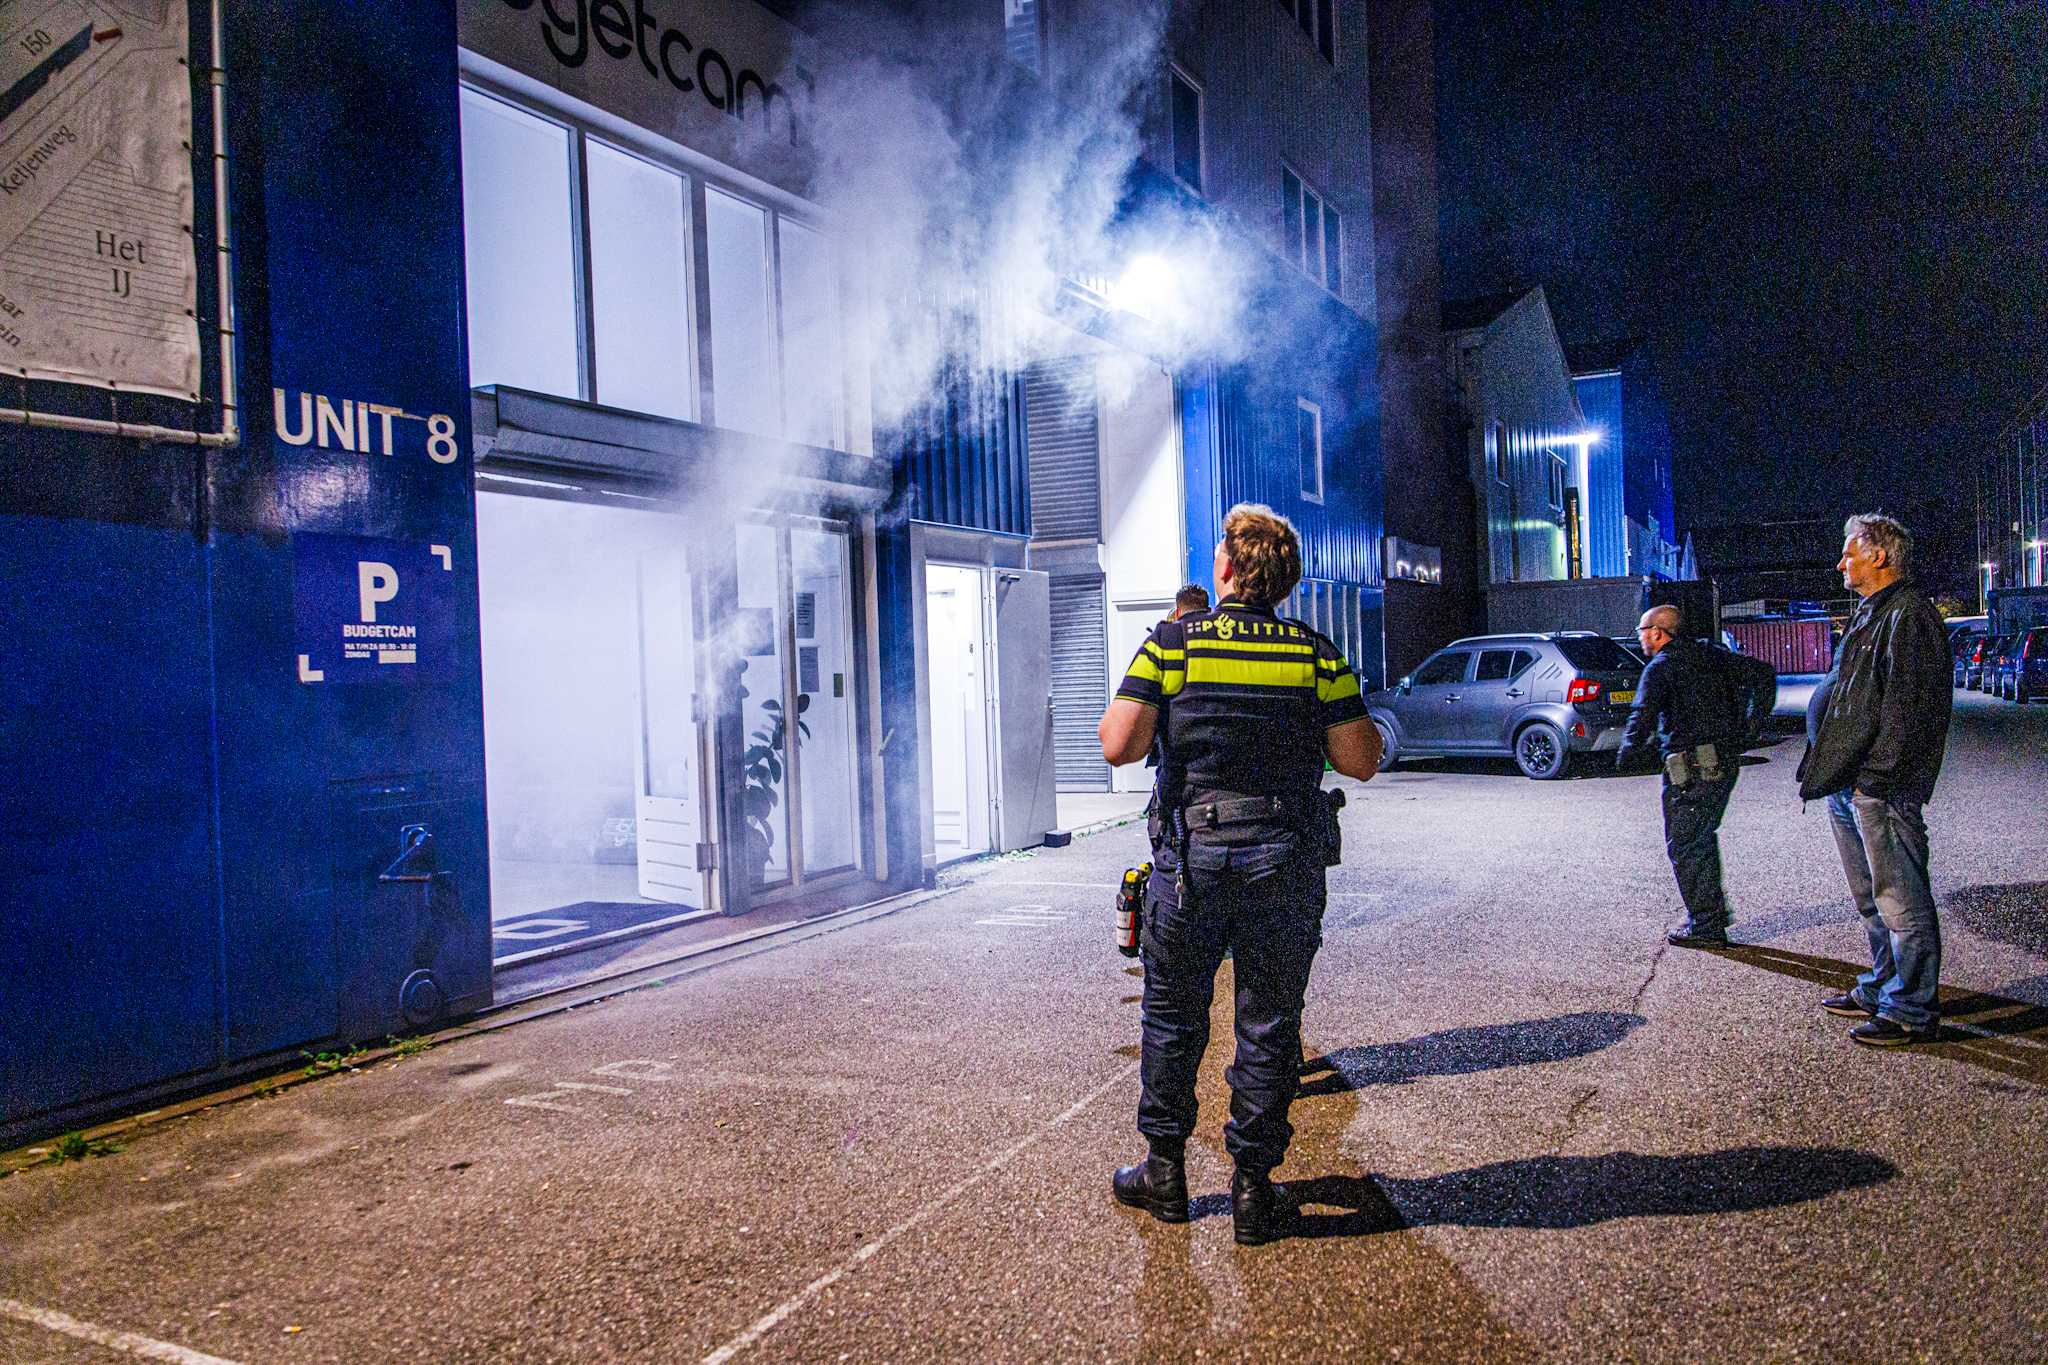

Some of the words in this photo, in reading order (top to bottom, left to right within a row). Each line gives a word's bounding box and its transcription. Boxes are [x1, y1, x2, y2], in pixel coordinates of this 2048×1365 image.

[20, 29, 51, 56] 150
[504, 0, 798, 147] getcam
[95, 229, 146, 264] Het
[111, 267, 130, 298] IJ
[273, 387, 403, 456] UNIT
[426, 413, 458, 464] 8
[358, 560, 399, 622] P
[343, 624, 416, 638] BUDGETCAM
